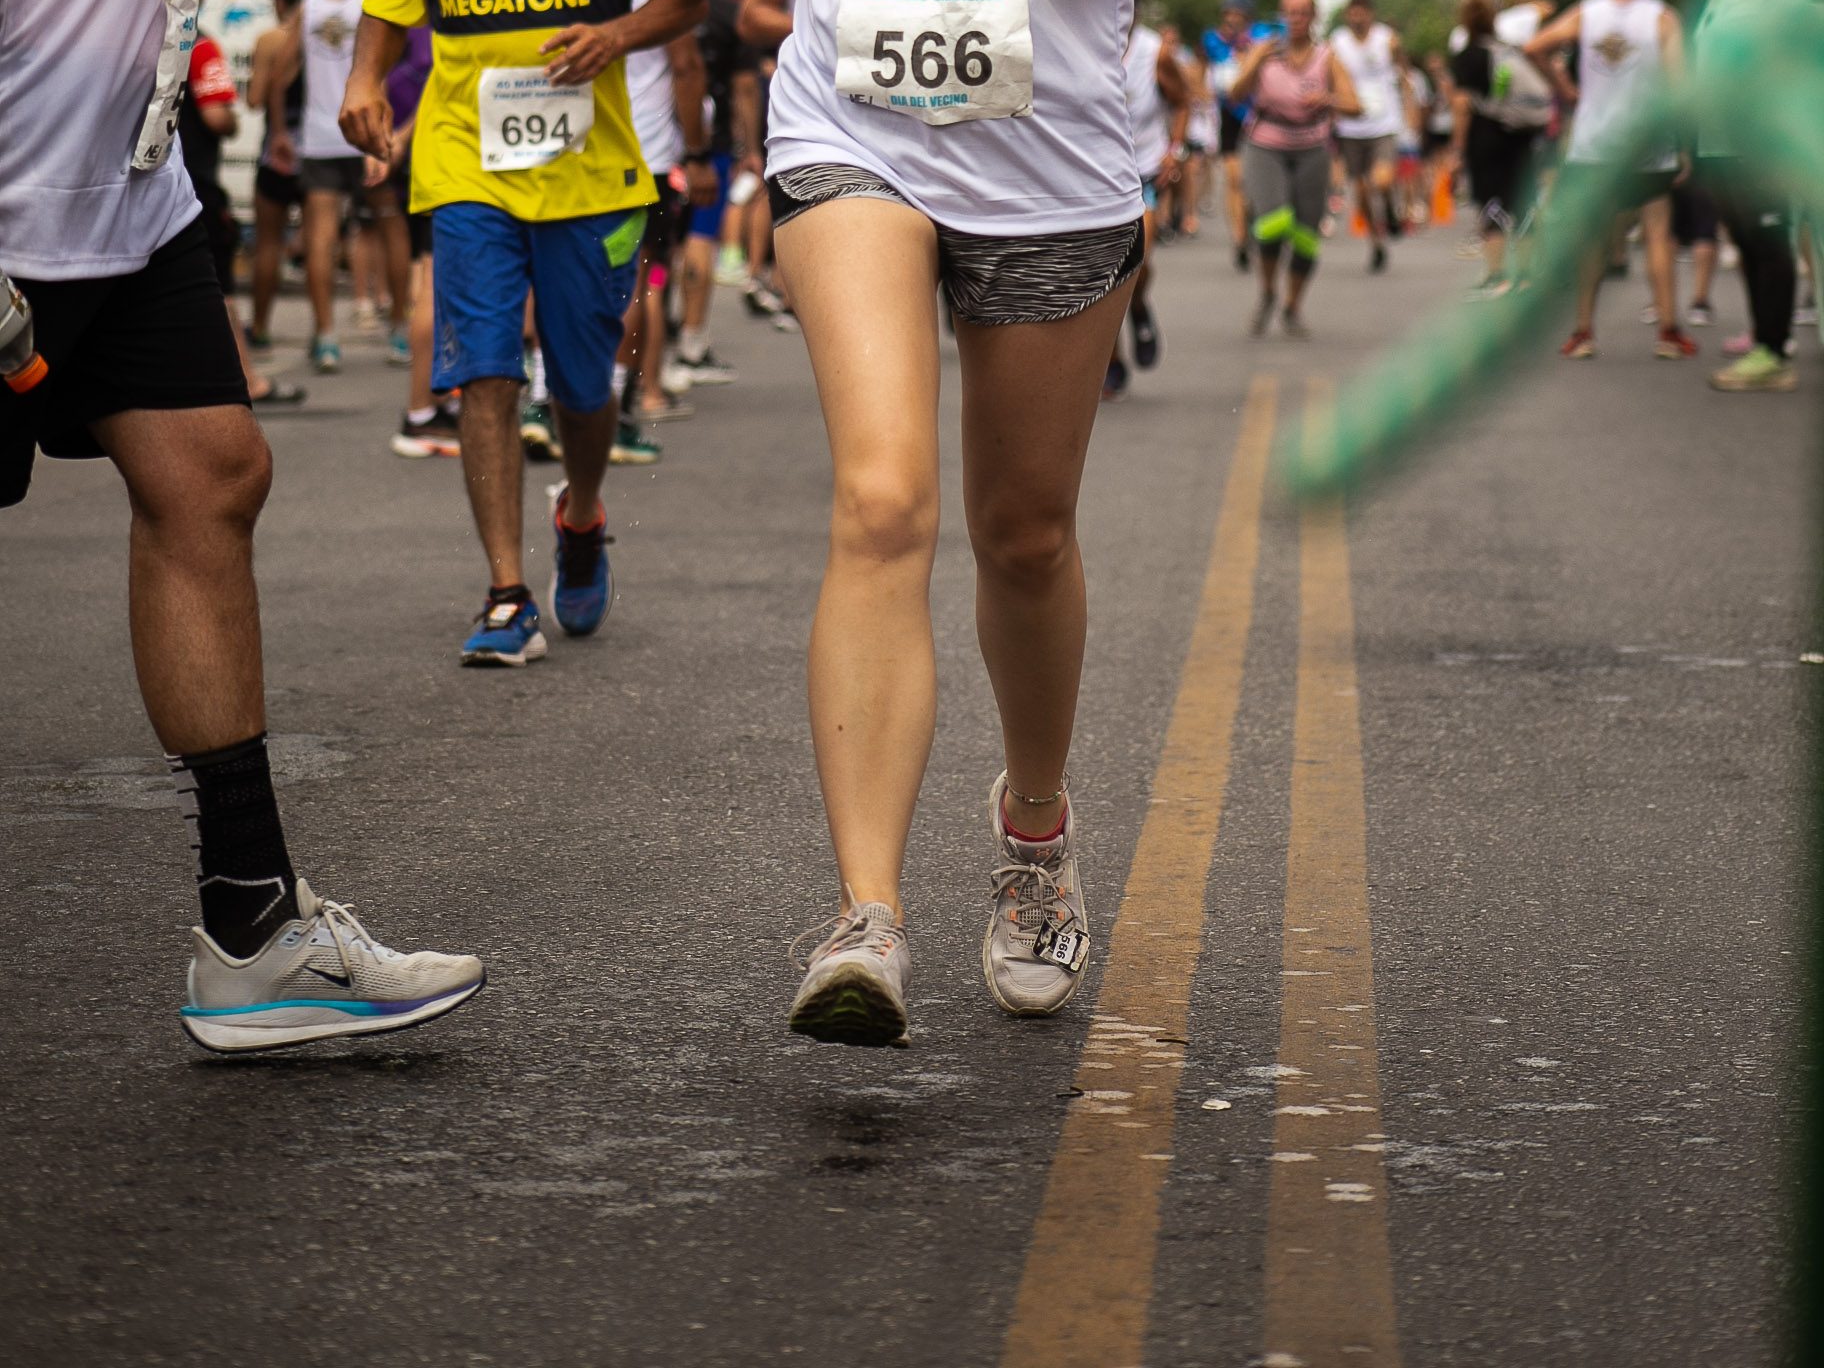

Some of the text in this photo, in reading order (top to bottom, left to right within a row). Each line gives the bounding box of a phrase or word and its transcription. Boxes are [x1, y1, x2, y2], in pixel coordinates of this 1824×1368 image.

[870, 30, 993, 89] 566
[514, 78, 550, 89] MARA
[890, 93, 968, 108] DIA DEL VECINO
[501, 113, 574, 147] 694
[1056, 935, 1071, 960] 566
